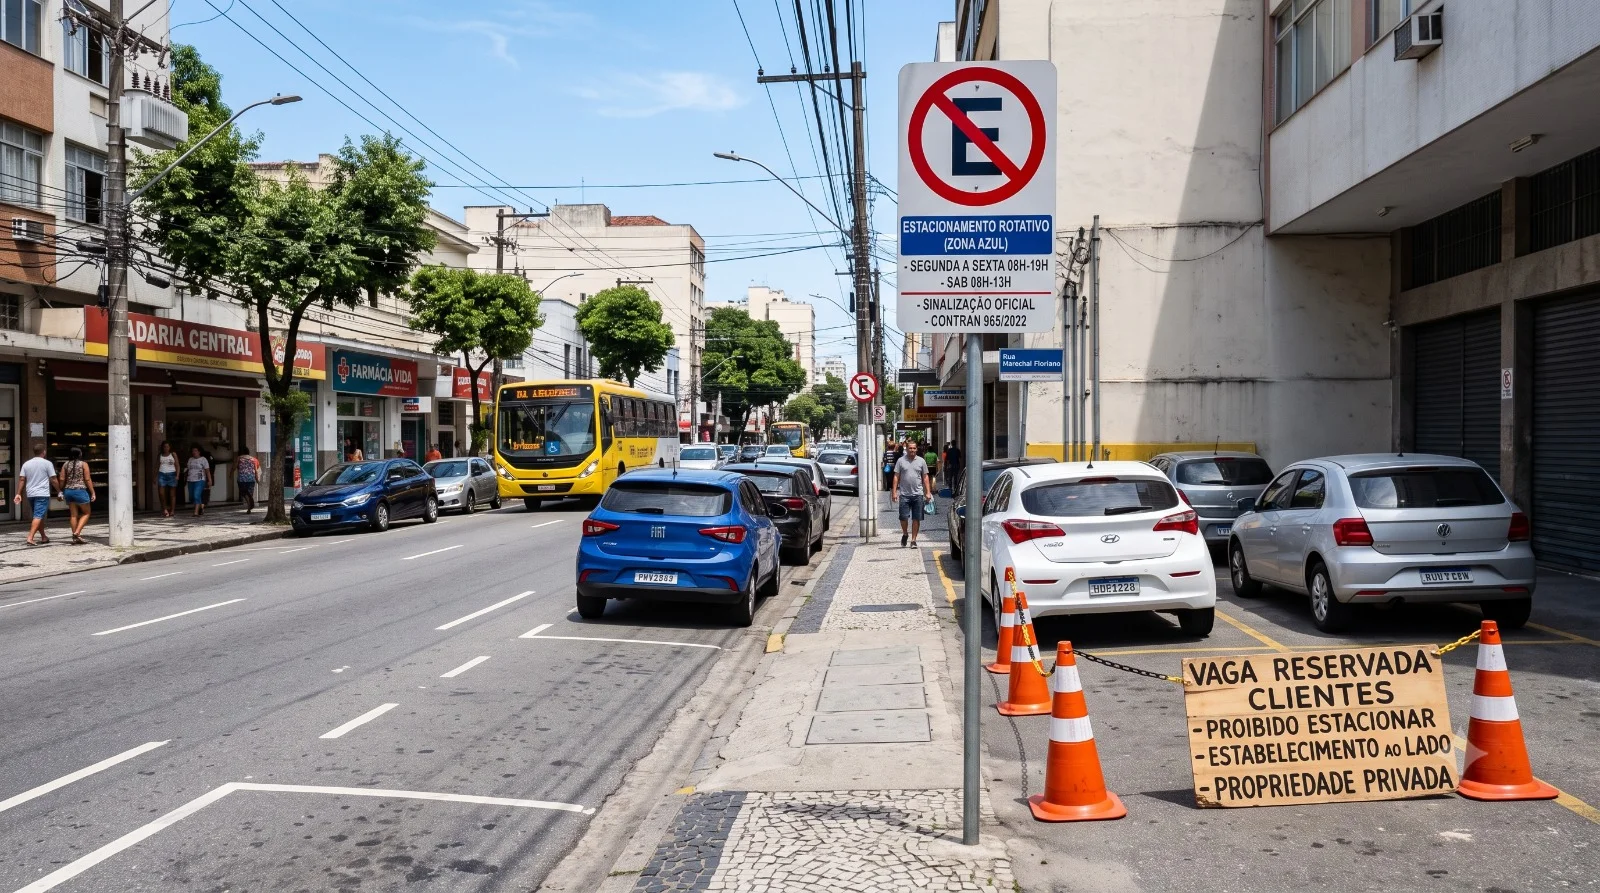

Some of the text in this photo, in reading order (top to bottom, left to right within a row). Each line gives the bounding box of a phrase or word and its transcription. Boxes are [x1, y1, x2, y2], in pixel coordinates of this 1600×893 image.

[952, 97, 1002, 176] E
[903, 219, 1050, 233] ESTACIONAMENTO ROTATIVO
[944, 237, 1009, 252] (ZONA AZUL)
[910, 259, 960, 272] SEGUNDA
[962, 259, 970, 271] A
[972, 259, 1005, 271] SEXTA
[1007, 259, 1048, 271] 08H-19H
[947, 276, 968, 288] SAB
[970, 276, 1011, 288] 08H-13H
[923, 296, 992, 313] SINALIZAÇÃO
[994, 298, 1035, 310] OFICIAL
[931, 315, 981, 327] CONTRAN
[984, 315, 1027, 327] 965/2022
[189, 329, 253, 357] CENTRAL
[351, 363, 412, 384] FARMÁCIA VIDA
[651, 526, 666, 539] FIAT
[1189, 649, 1432, 686] VAGA RESERVADA
[1248, 680, 1395, 711] CLIENTES
[1206, 715, 1299, 739] PROIBIDO
[1307, 708, 1436, 734] ESTACIONAR
[1209, 737, 1379, 767] ESTABELECIMENTO
[1385, 743, 1401, 758] AO
[1404, 734, 1451, 757] LADO
[1214, 770, 1356, 801] PROPRIEDADE
[1363, 765, 1454, 793] PRIVADA
